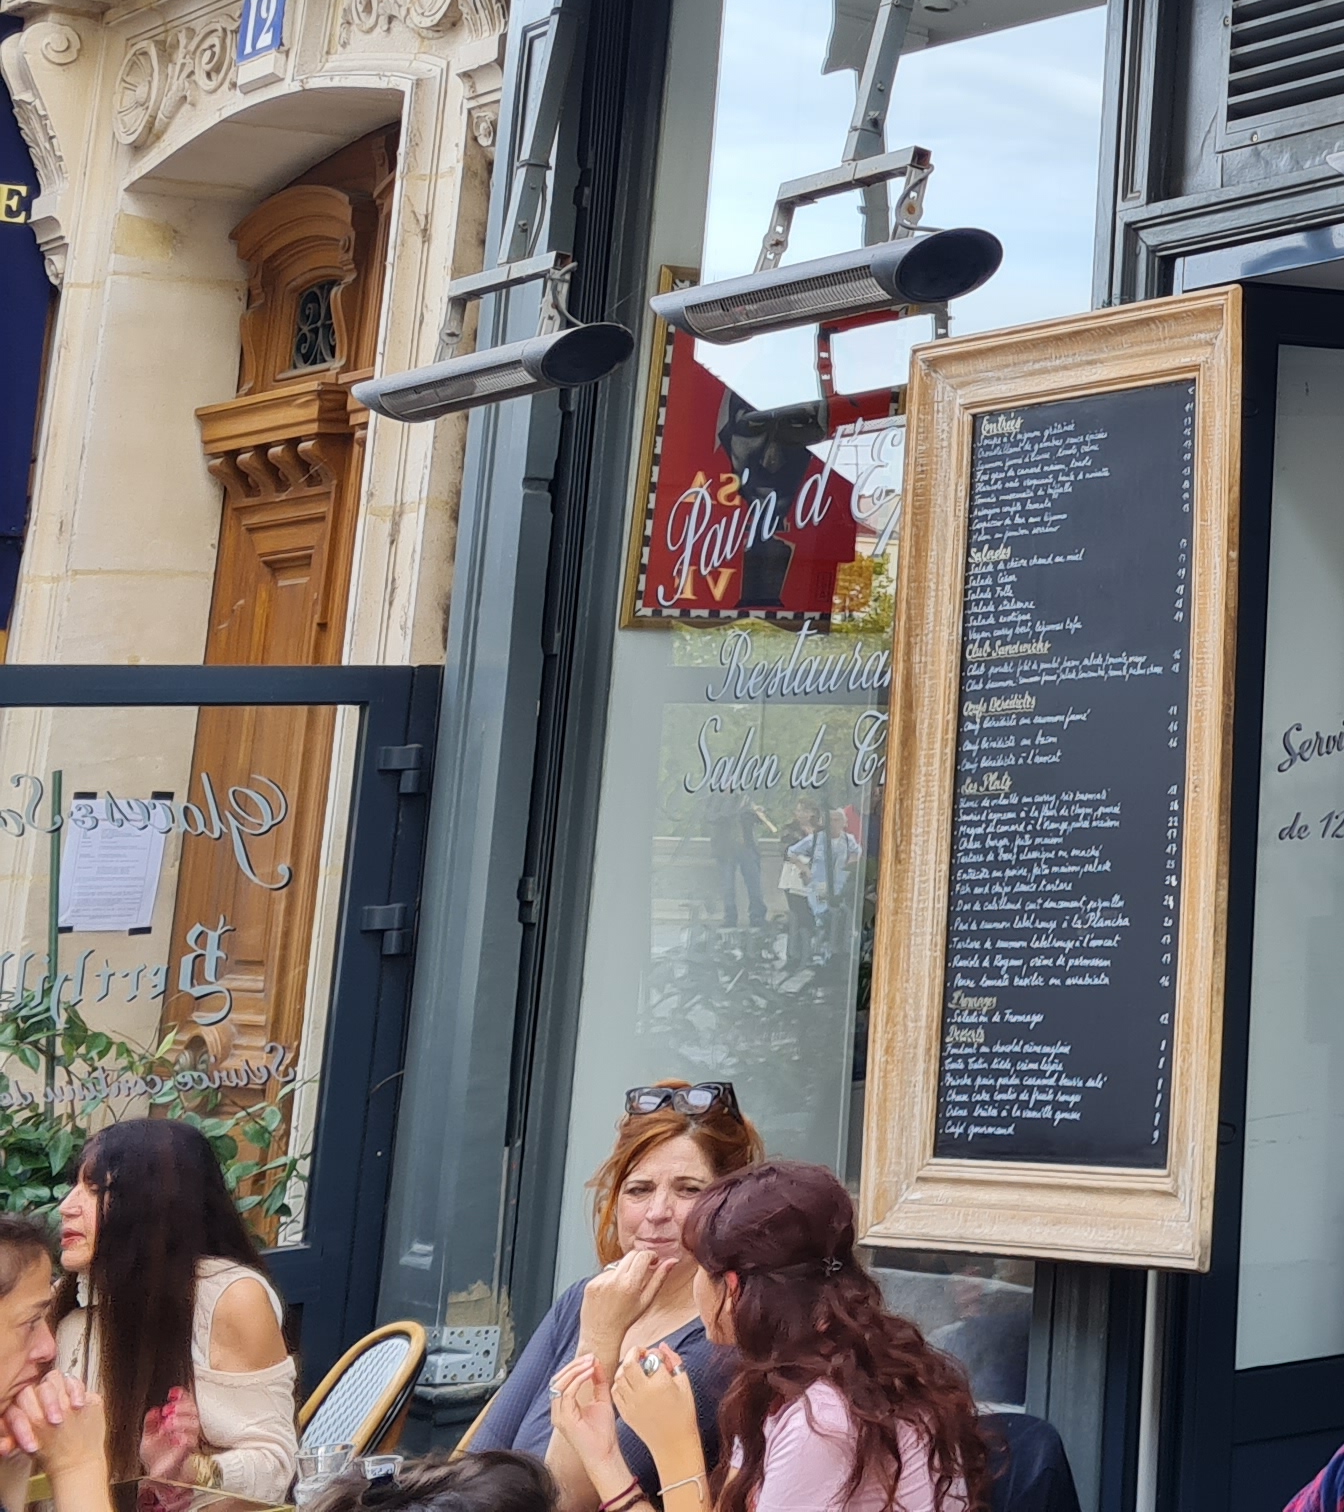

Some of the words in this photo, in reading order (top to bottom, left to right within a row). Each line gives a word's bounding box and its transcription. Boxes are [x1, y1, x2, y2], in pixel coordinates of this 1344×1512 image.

[657, 478, 780, 608] Pain
[684, 715, 782, 792] Salon
[790, 725, 831, 790] de
[1278, 811, 1311, 840] de
